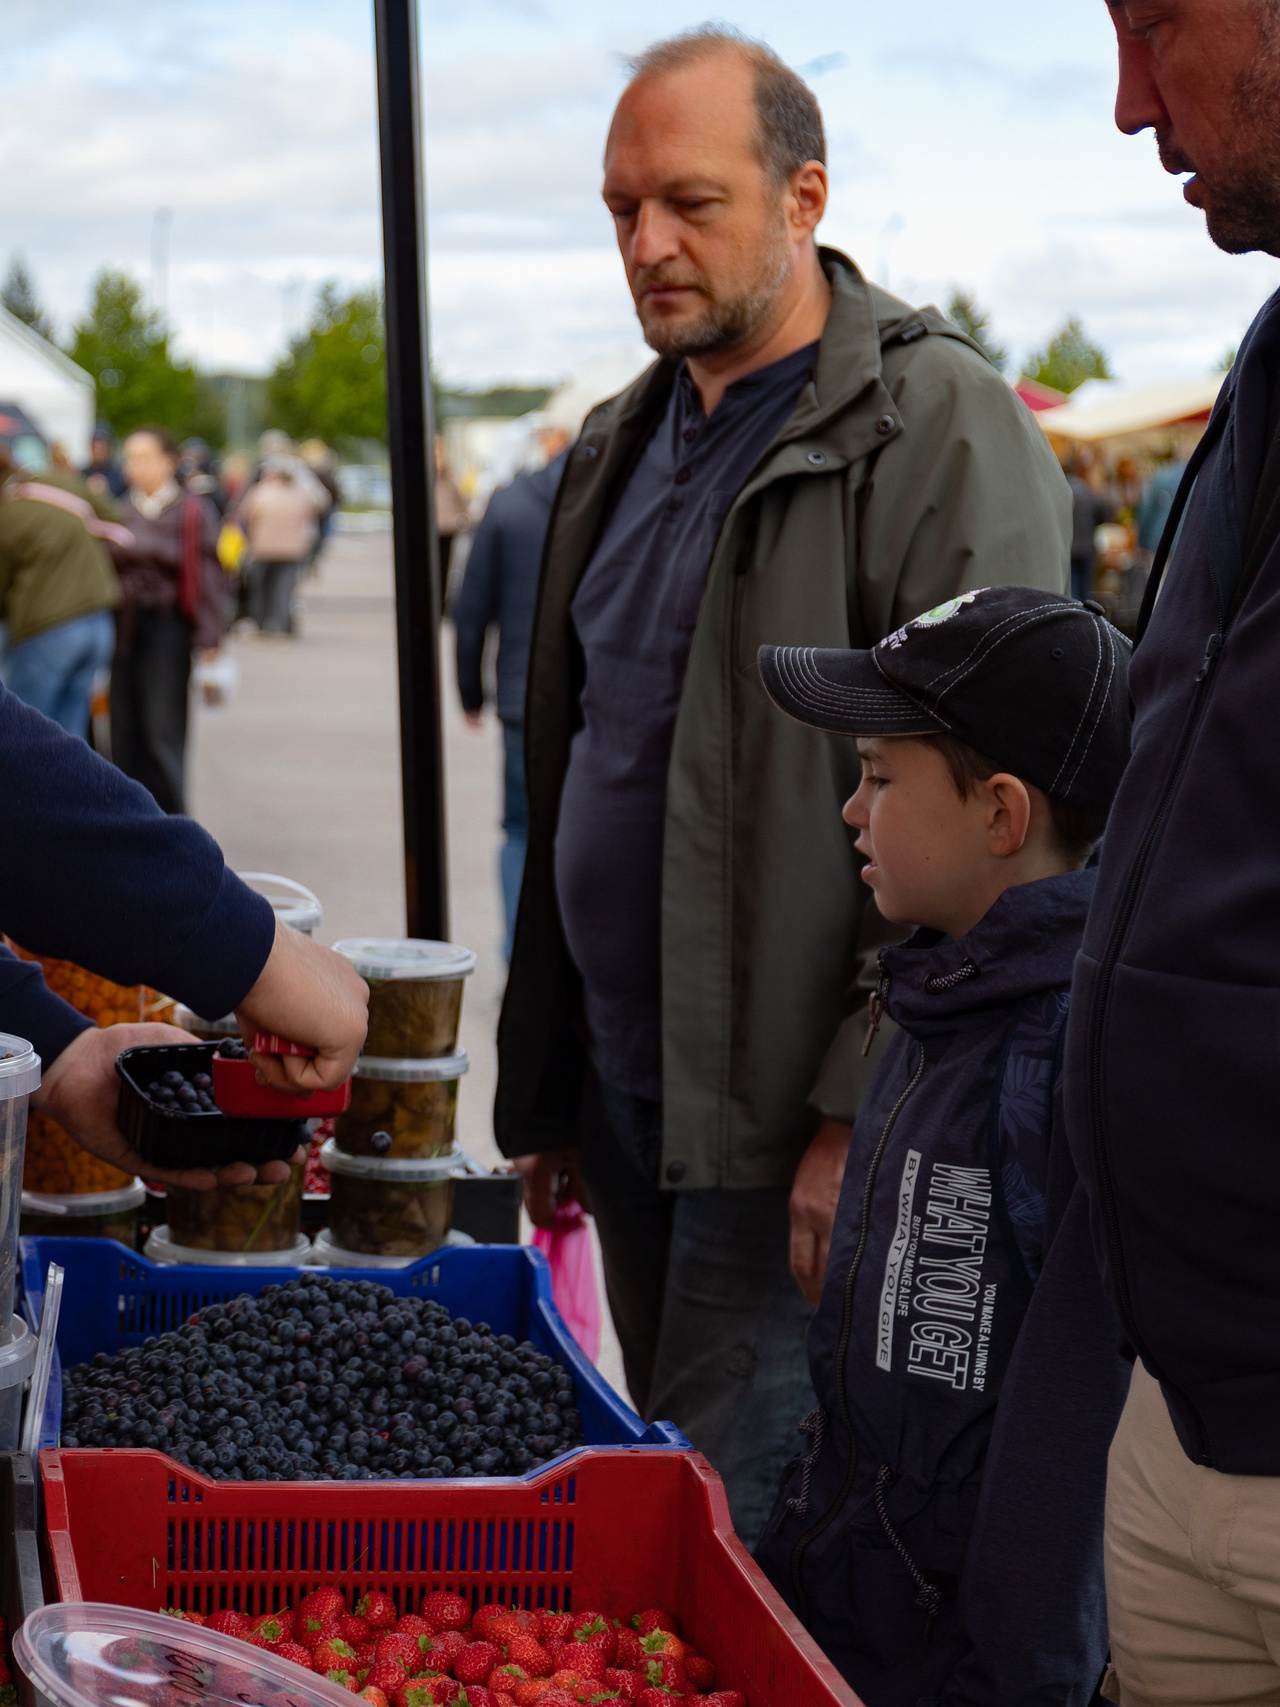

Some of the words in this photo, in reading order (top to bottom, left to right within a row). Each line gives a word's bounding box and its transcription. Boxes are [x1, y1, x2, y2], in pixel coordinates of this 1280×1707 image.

[906, 1157, 917, 1186] BY
[922, 1163, 991, 1253] WHAT
[893, 1193, 910, 1256] WHAT
[911, 1215, 921, 1237] BUT
[907, 1237, 918, 1258] YOU
[885, 1261, 898, 1306] YOU
[900, 1259, 915, 1287] MAKE
[913, 1256, 983, 1321] YOU
[983, 1283, 997, 1304] YOU
[897, 1295, 909, 1317] LIFE
[979, 1305, 994, 1334] MAKE
[880, 1311, 891, 1363] GIVE
[907, 1321, 972, 1390] GET
[974, 1343, 989, 1376] LIVING
[973, 1377, 985, 1391] BY
